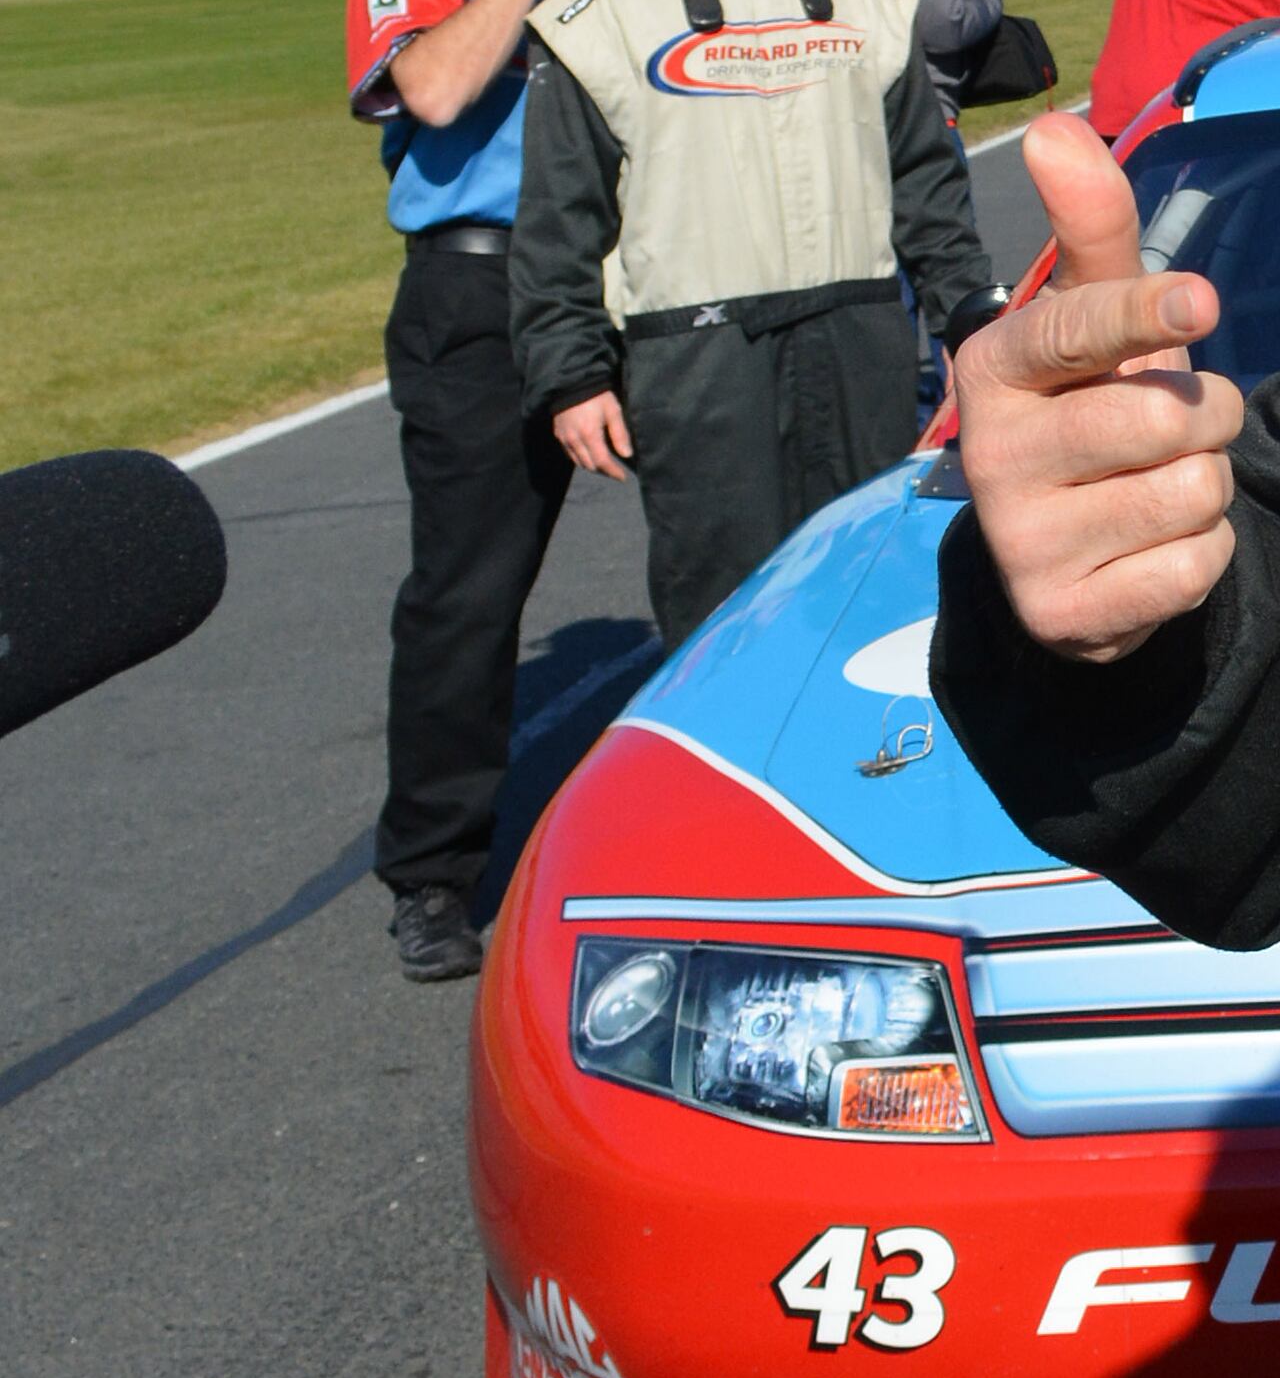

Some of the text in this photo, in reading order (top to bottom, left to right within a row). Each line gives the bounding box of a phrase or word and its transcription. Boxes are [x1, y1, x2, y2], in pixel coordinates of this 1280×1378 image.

[704, 39, 865, 62] RICHARD PETTY
[706, 58, 866, 79] DRIVING EXPERIENCE
[770, 1224, 956, 1354] 43
